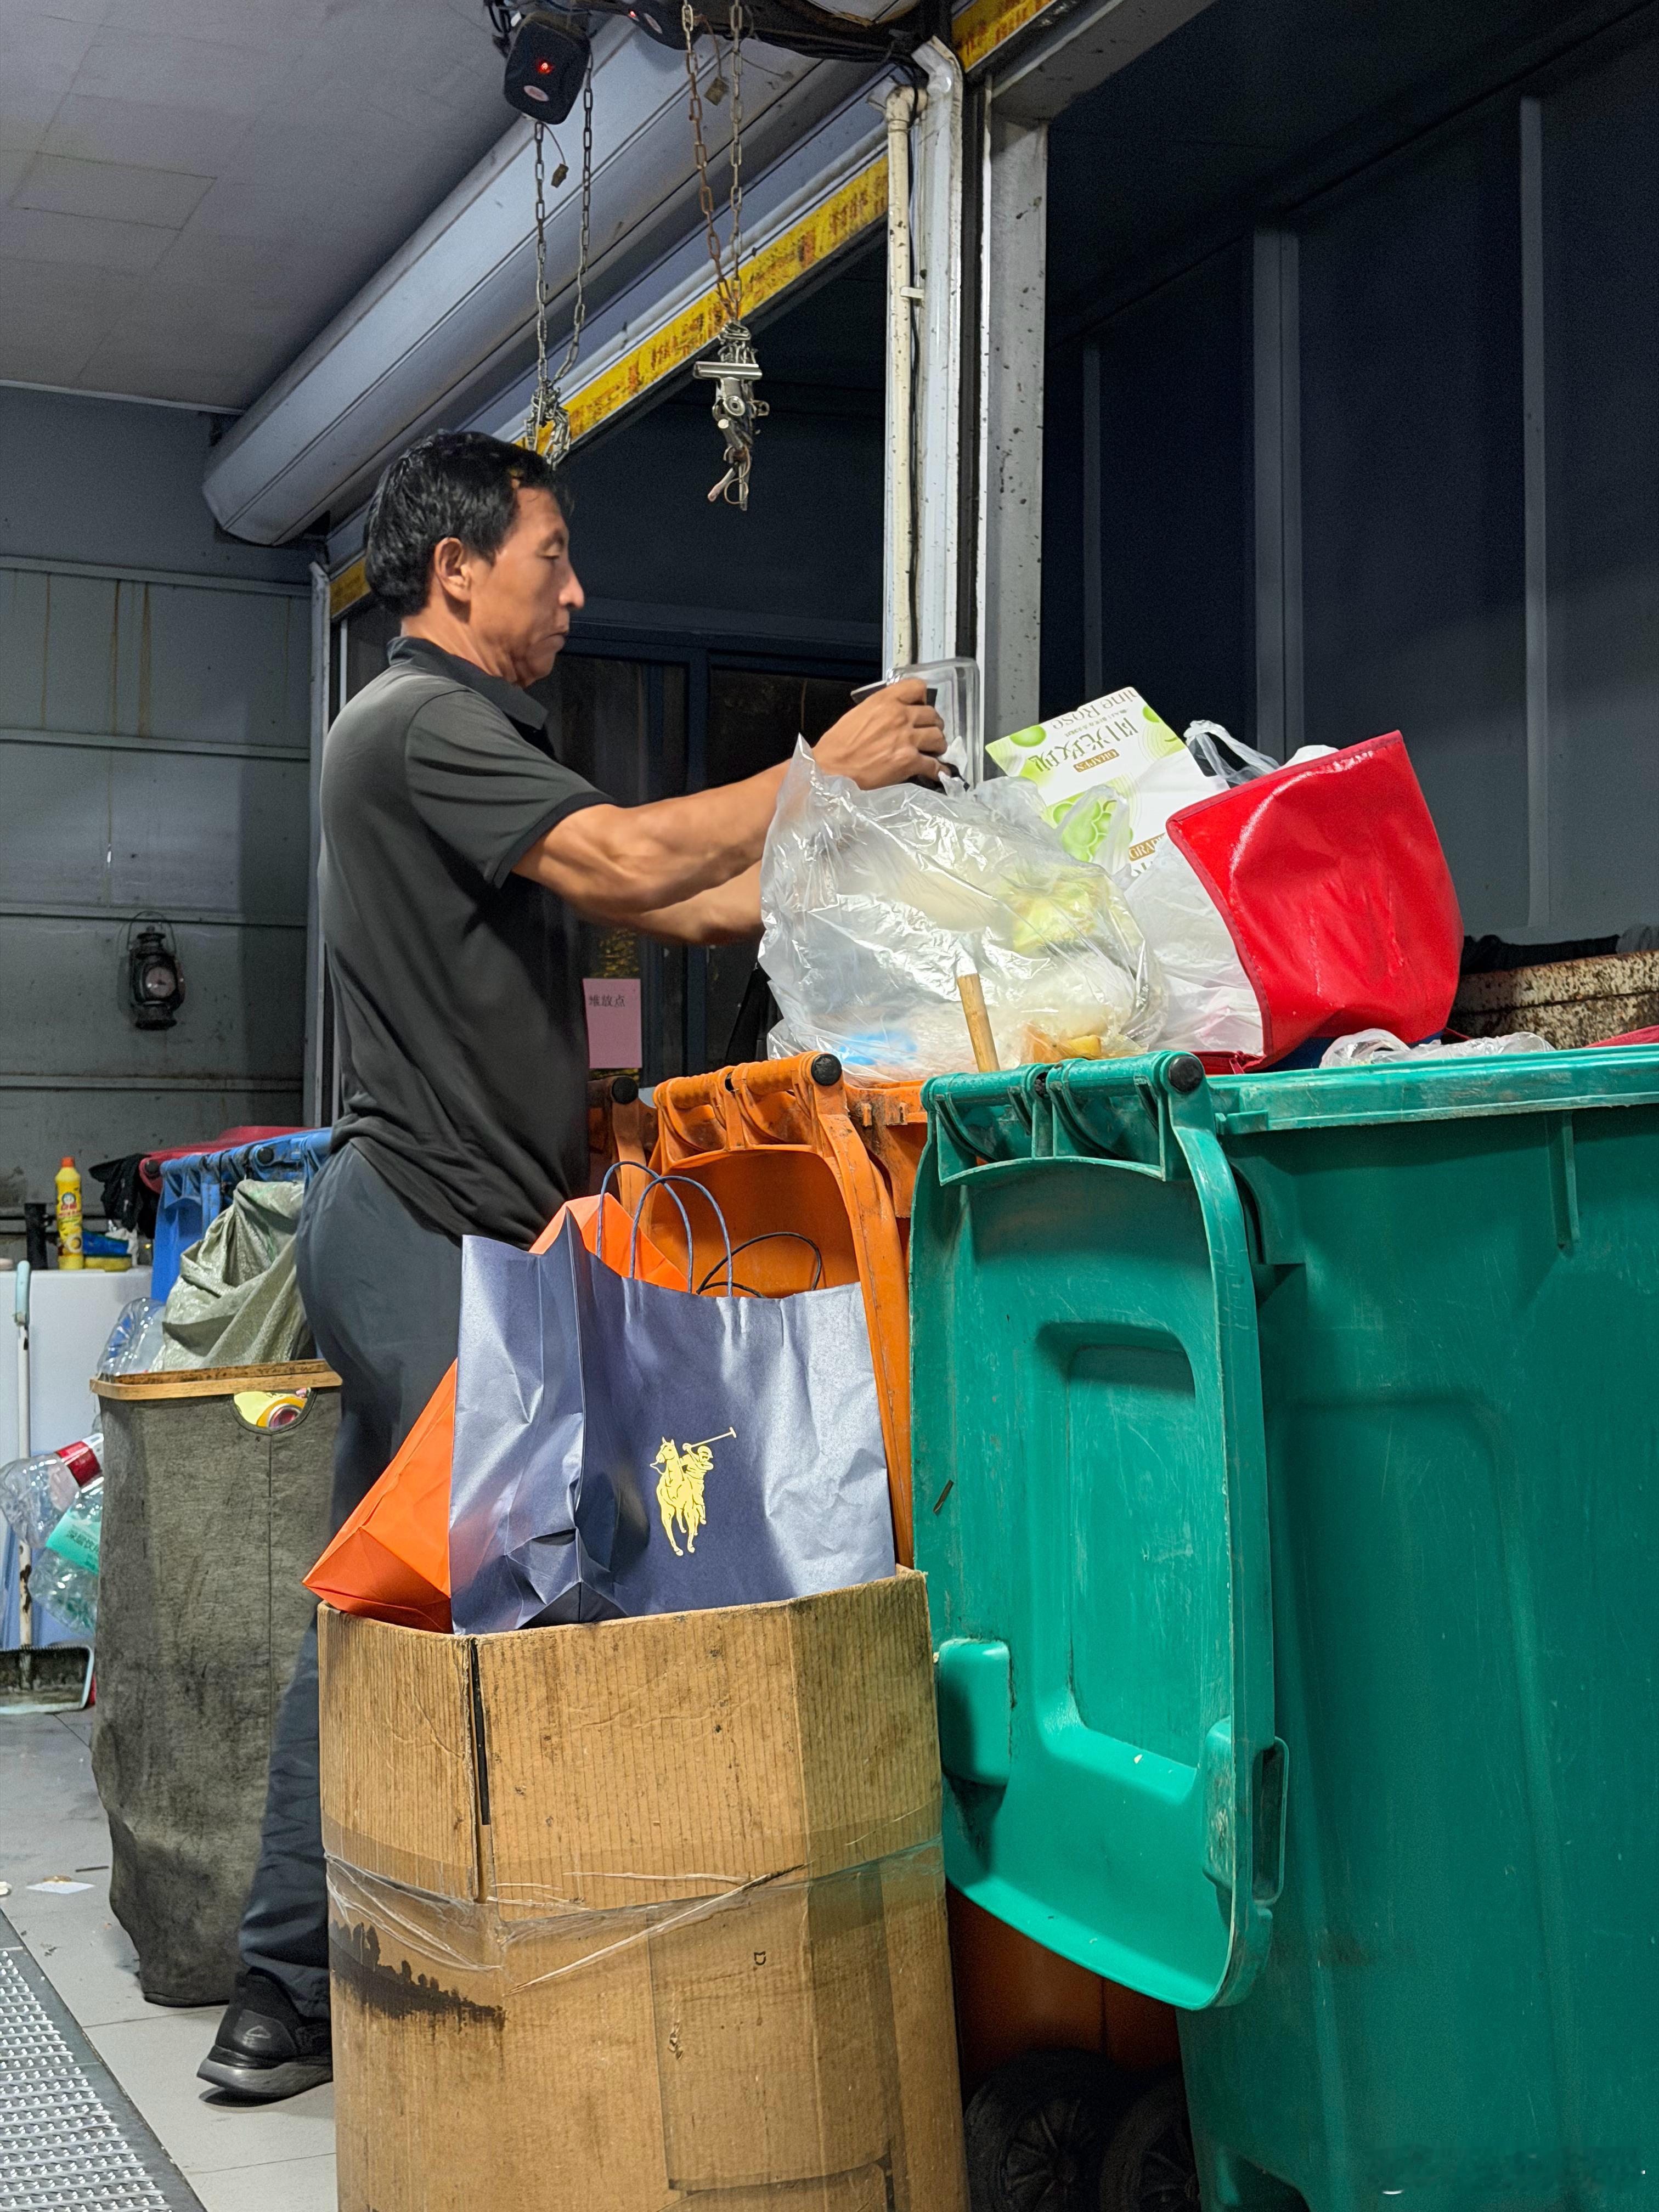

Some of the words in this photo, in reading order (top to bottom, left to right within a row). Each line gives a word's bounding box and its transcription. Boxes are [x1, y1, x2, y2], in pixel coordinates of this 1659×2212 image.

[1050, 704, 1101, 730] Rose
[1028, 717, 1139, 772] 阳光玫瑰
